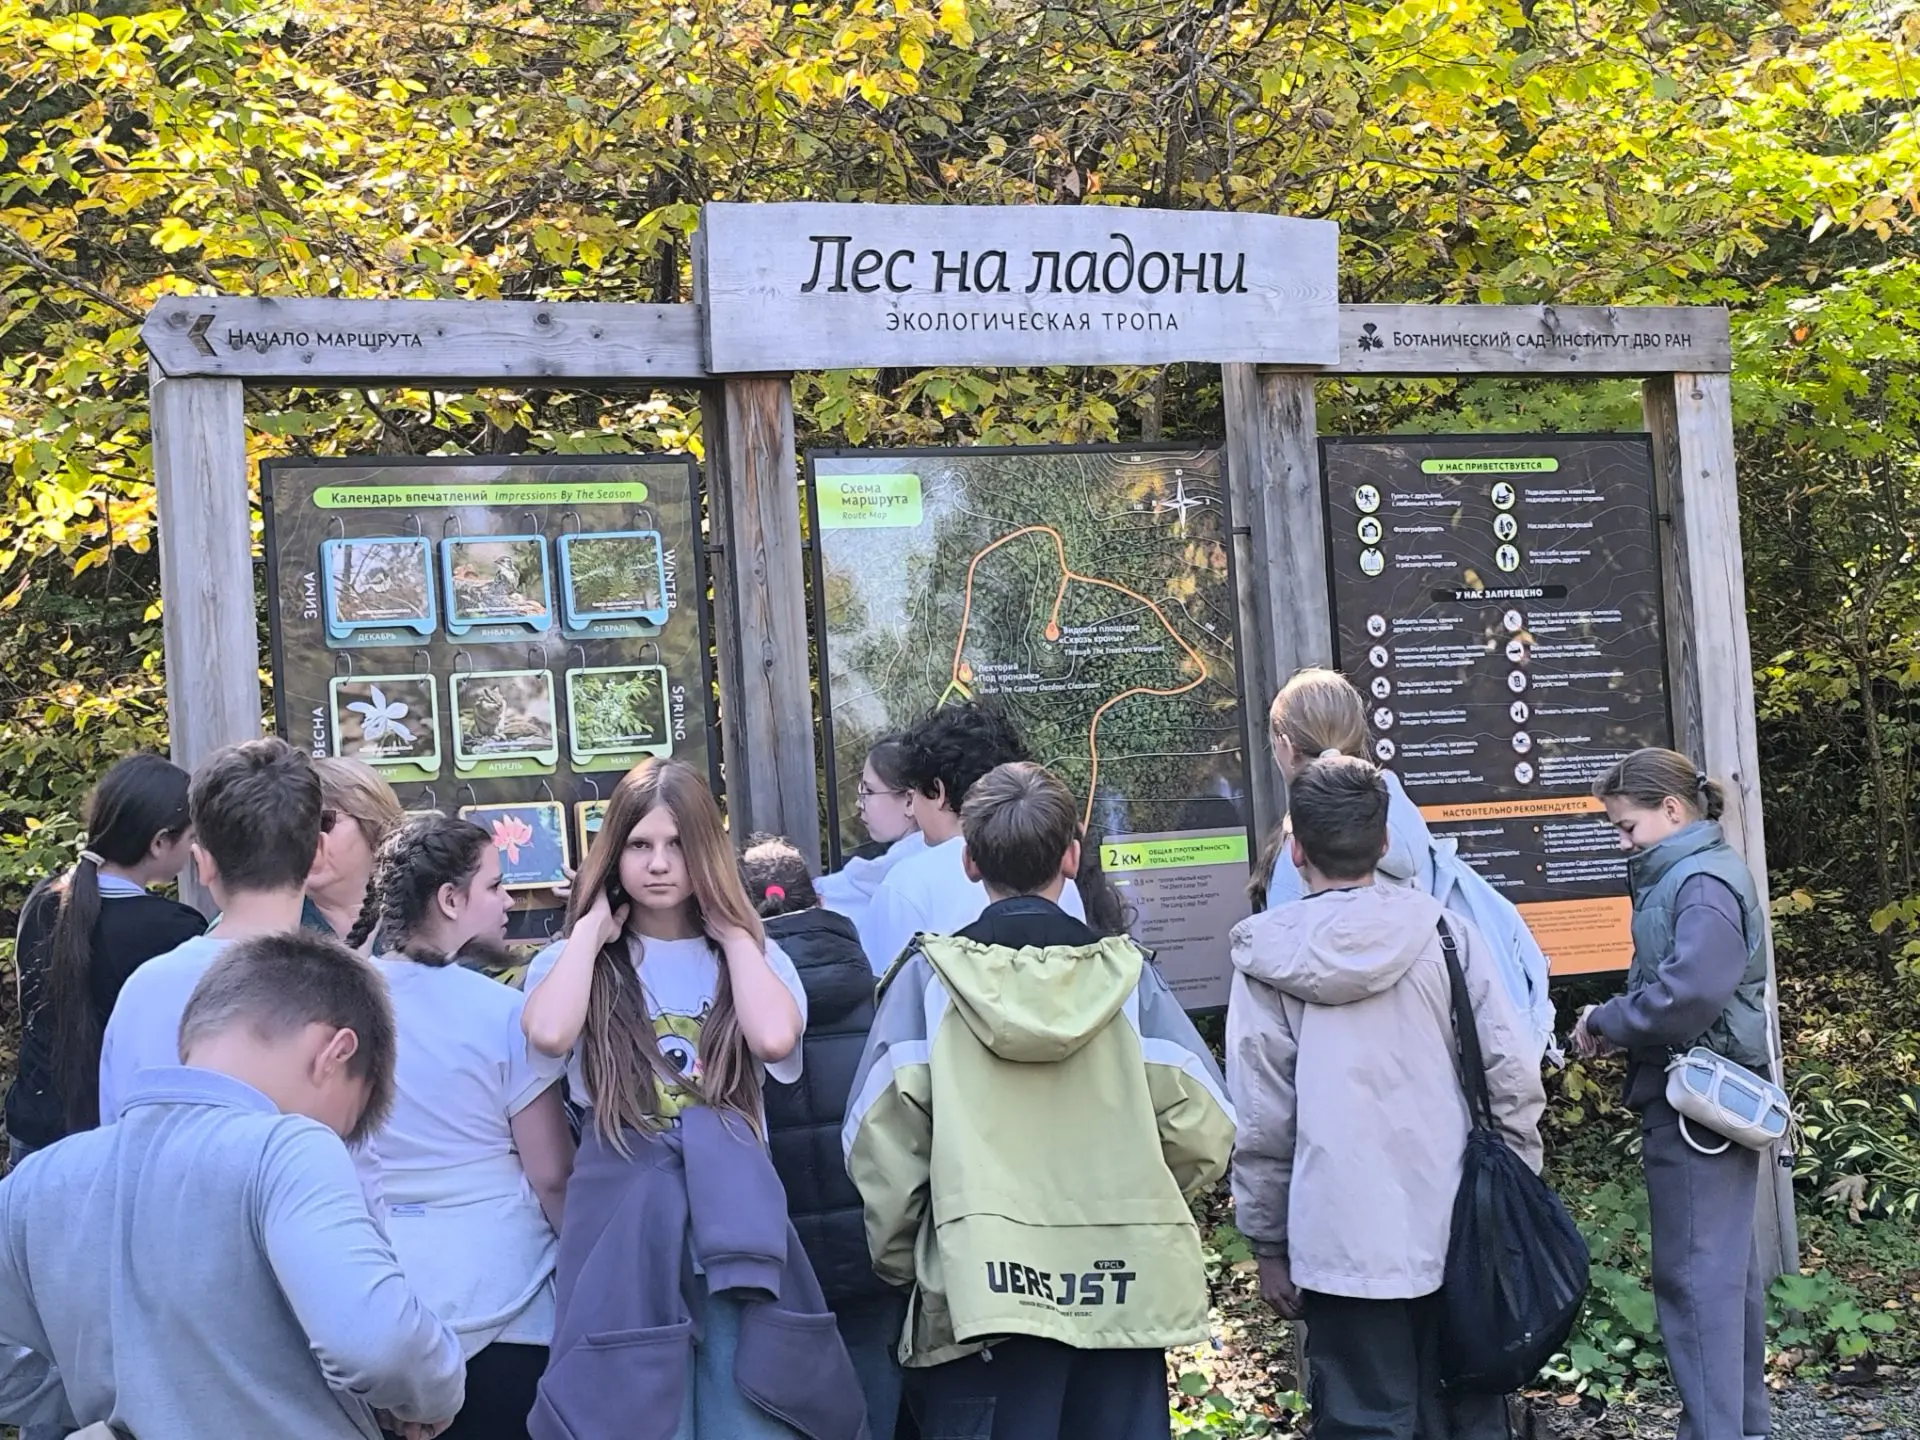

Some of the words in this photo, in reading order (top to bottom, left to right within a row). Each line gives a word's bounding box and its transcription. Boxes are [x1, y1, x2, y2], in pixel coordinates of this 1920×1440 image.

[800, 235, 916, 293] Лес
[932, 249, 1010, 293] на
[1024, 232, 1248, 295] ладони
[886, 312, 1091, 332] ЭКОЛОГИЧЕСКАЯ
[1101, 312, 1179, 332] ТРОПА
[317, 332, 423, 347] МАРШРУТА
[1632, 333, 1661, 350] ДВО
[1666, 333, 1692, 348] РАН
[1438, 463, 1445, 472] У
[1446, 462, 1463, 472] НАС
[1464, 461, 1543, 472] ПРИВЕТСТВУЕТСЯ
[840, 482, 881, 494] Схема
[331, 492, 402, 505] Календарь
[405, 490, 488, 503] впечатлений
[495, 490, 557, 503] Impressions
[561, 490, 572, 502] By
[575, 489, 595, 500] The
[596, 489, 632, 500] Season
[842, 495, 908, 508] маршрута
[842, 511, 867, 519] Route
[869, 511, 888, 520] Map
[663, 548, 677, 609] WINTER
[304, 571, 318, 619] ЗИМА
[1455, 592, 1462, 600] У
[1463, 590, 1483, 600] НАС
[1484, 587, 1543, 600] ЗАПРЕЩЕНО
[482, 629, 514, 637] ЯНВАРЬ
[593, 625, 630, 633] ФЕВРАЛЬ
[1099, 624, 1140, 633] площадка
[358, 632, 397, 642] ДЕКАБРЬ
[978, 664, 1018, 673] Лекторий
[672, 685, 686, 741] SPRING
[312, 706, 326, 759] ВЕСНА
[611, 756, 631, 764] МАЙ
[488, 762, 523, 772] АПРЕЛЬ
[1443, 806, 1512, 817] НАСТОЯТЕЛЬНО
[1514, 801, 1588, 813] РЕКОМЕНДУЕТСЯ
[1109, 850, 1119, 866] 2
[1122, 854, 1142, 866] КМ
[1148, 848, 1173, 856] ОБЩАЯ
[1170, 855, 1195, 863] LENGTH
[1098, 1261, 1123, 1269] YPCL
